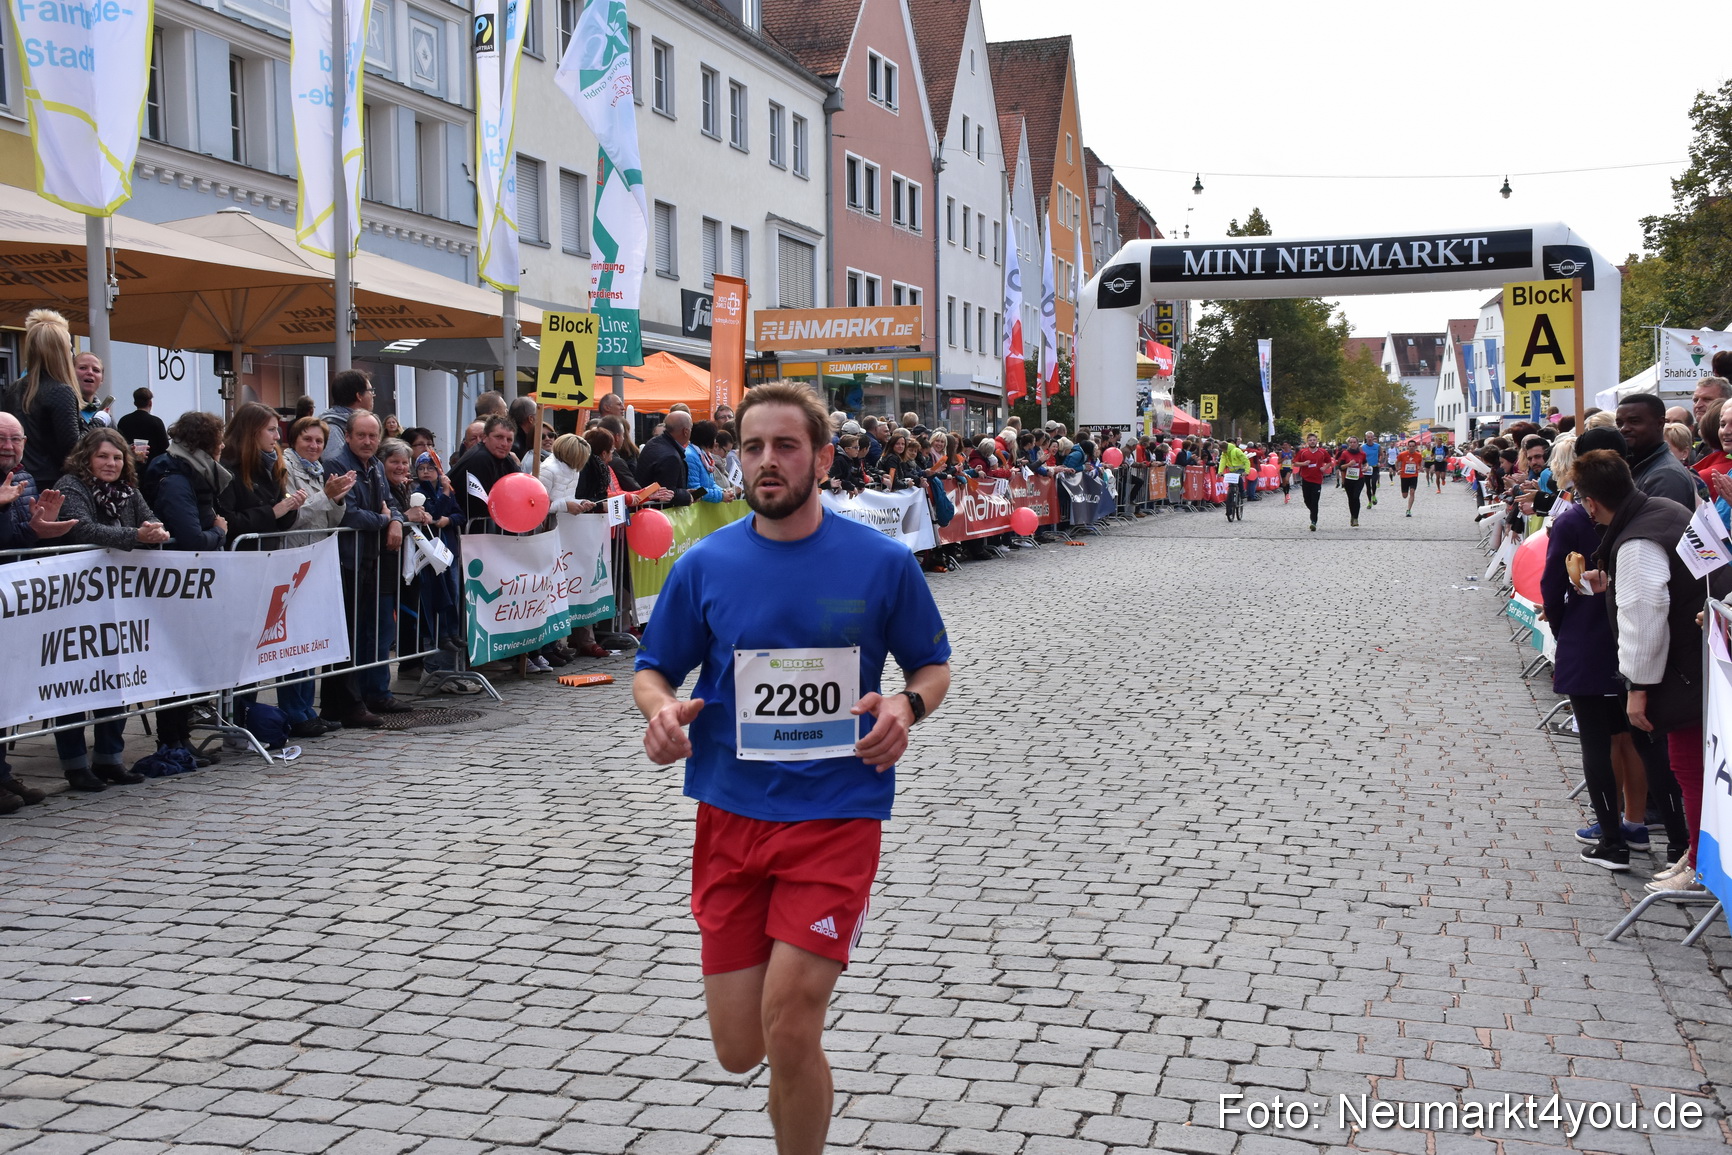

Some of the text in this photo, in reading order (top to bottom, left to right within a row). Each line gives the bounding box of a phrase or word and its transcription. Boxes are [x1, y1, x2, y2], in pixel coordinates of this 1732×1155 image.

[1182, 237, 1495, 276] MINI NEUMARKT.
[1513, 284, 1573, 306] Block
[549, 315, 593, 334] Block
[760, 317, 914, 341] RUNMARKT.DE
[1521, 314, 1566, 367] A
[550, 341, 582, 386] A
[828, 362, 888, 373] RUNMARKT.DE
[1664, 368, 1697, 378] Shahid's
[1204, 402, 1213, 414] B
[1683, 525, 1705, 550] wn
[1, 565, 216, 619] LEBENSSPENDER
[40, 618, 150, 667] WERDEN!
[257, 638, 330, 665] JEDER EINZELNE ZÄHLT
[782, 658, 824, 668] BOCK
[38, 664, 147, 701] www.dkms.de
[754, 681, 841, 716] 2280
[773, 729, 823, 741] Andreas
[810, 924, 839, 939] adidas
